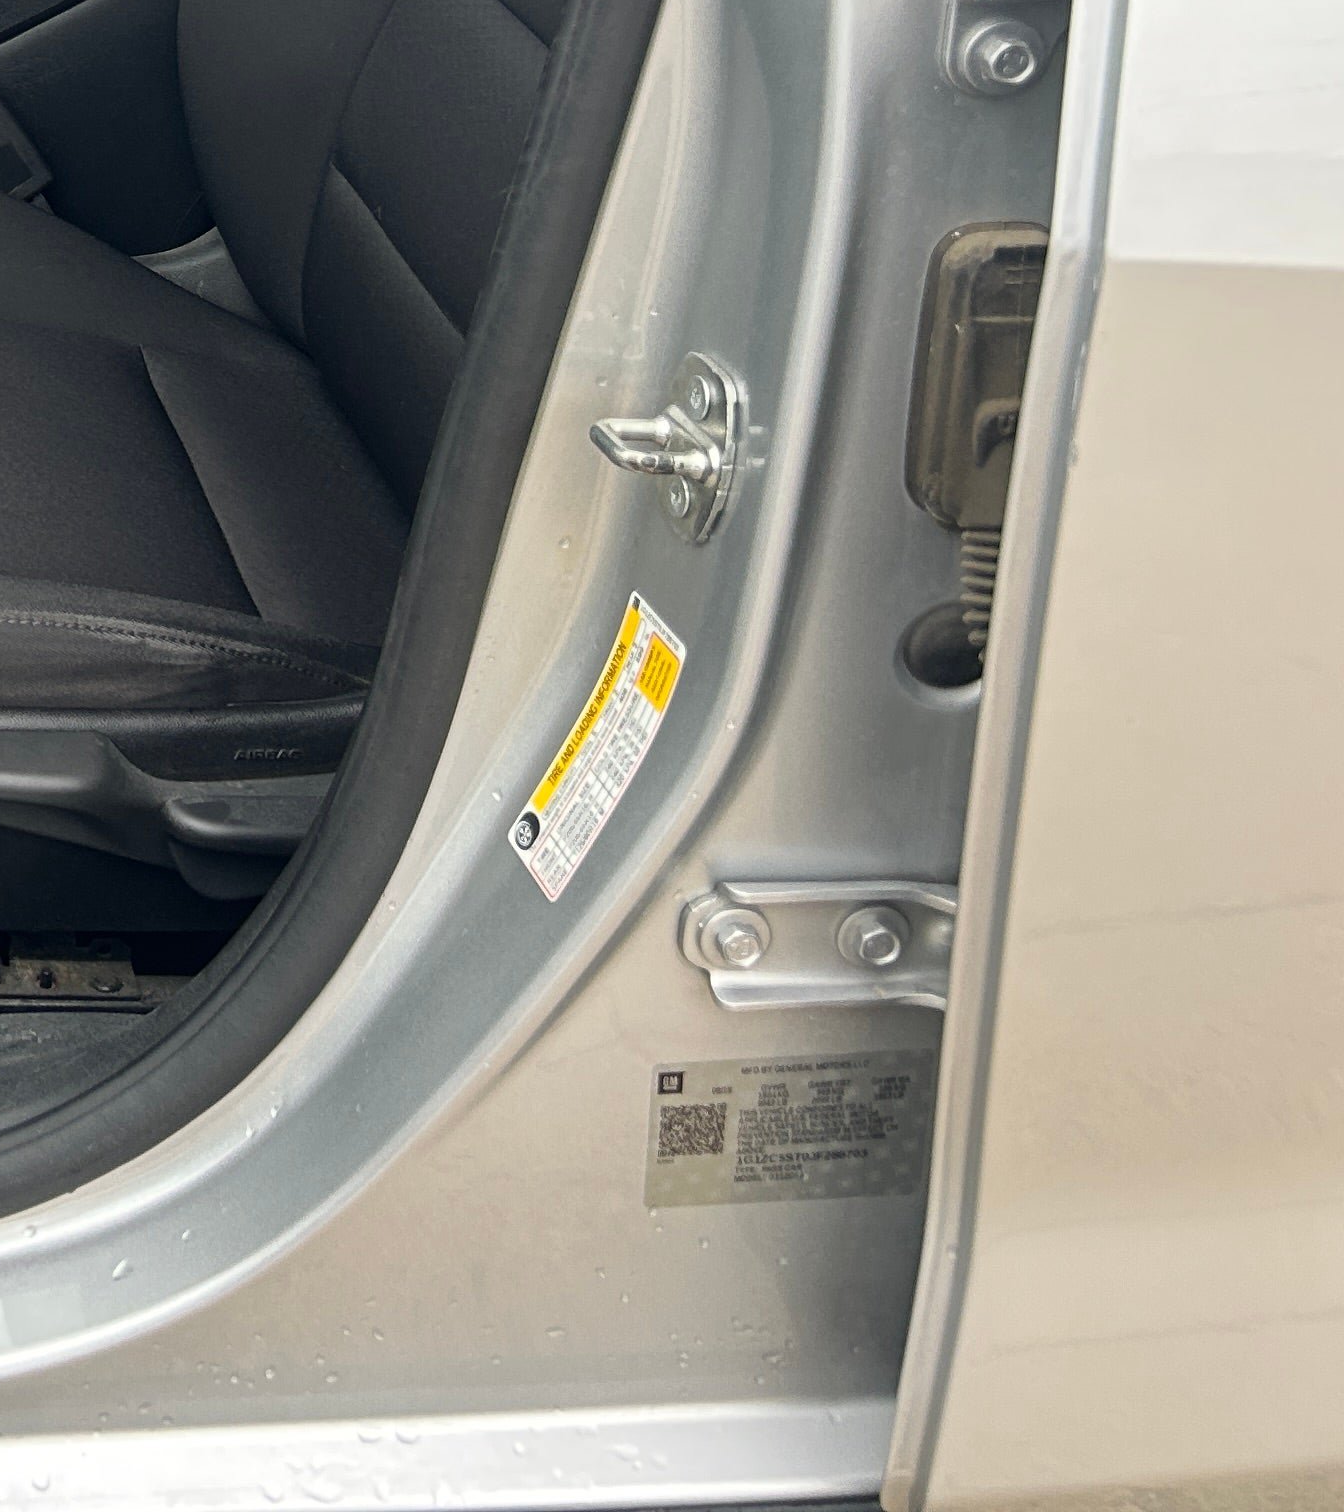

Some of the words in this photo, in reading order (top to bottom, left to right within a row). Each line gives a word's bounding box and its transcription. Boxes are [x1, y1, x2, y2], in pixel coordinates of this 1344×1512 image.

[547, 764, 563, 786] TIRE
[560, 743, 576, 766] AND
[571, 704, 597, 746] LOADING
[596, 641, 627, 707] INFORMATION
[233, 748, 300, 761] AIRBAG
